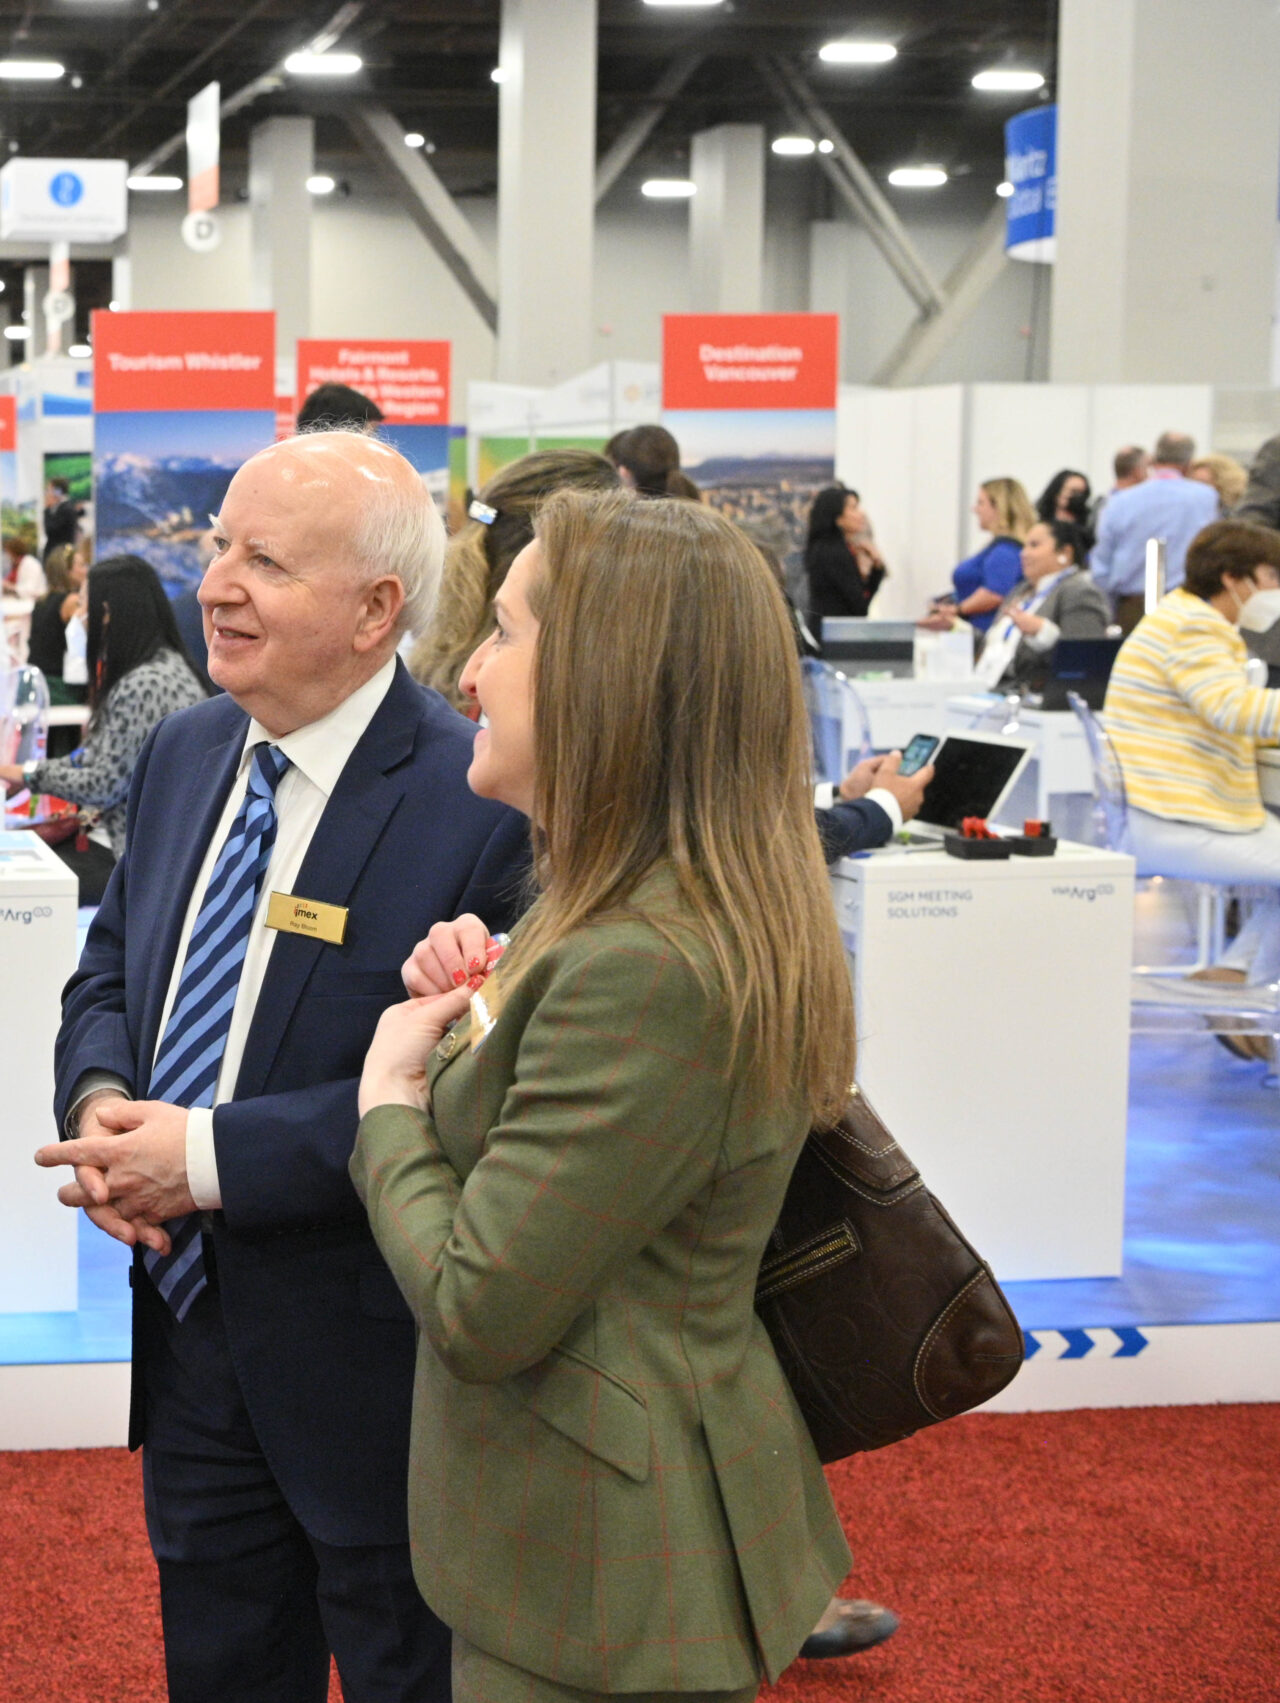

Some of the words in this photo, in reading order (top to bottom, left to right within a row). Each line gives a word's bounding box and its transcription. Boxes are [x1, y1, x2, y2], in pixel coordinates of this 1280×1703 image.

[108, 352, 183, 371] Tourism
[184, 351, 262, 371] Whistler
[338, 348, 410, 365] Fairmont
[698, 343, 803, 362] Destination
[309, 367, 360, 382] Hotels
[363, 367, 374, 381] &
[376, 367, 438, 382] Resorts
[703, 363, 799, 382] Vancouver
[379, 384, 445, 399] Western
[383, 401, 439, 418] Region
[919, 889, 973, 901] MEETING
[887, 906, 958, 918] SOLUTIONS
